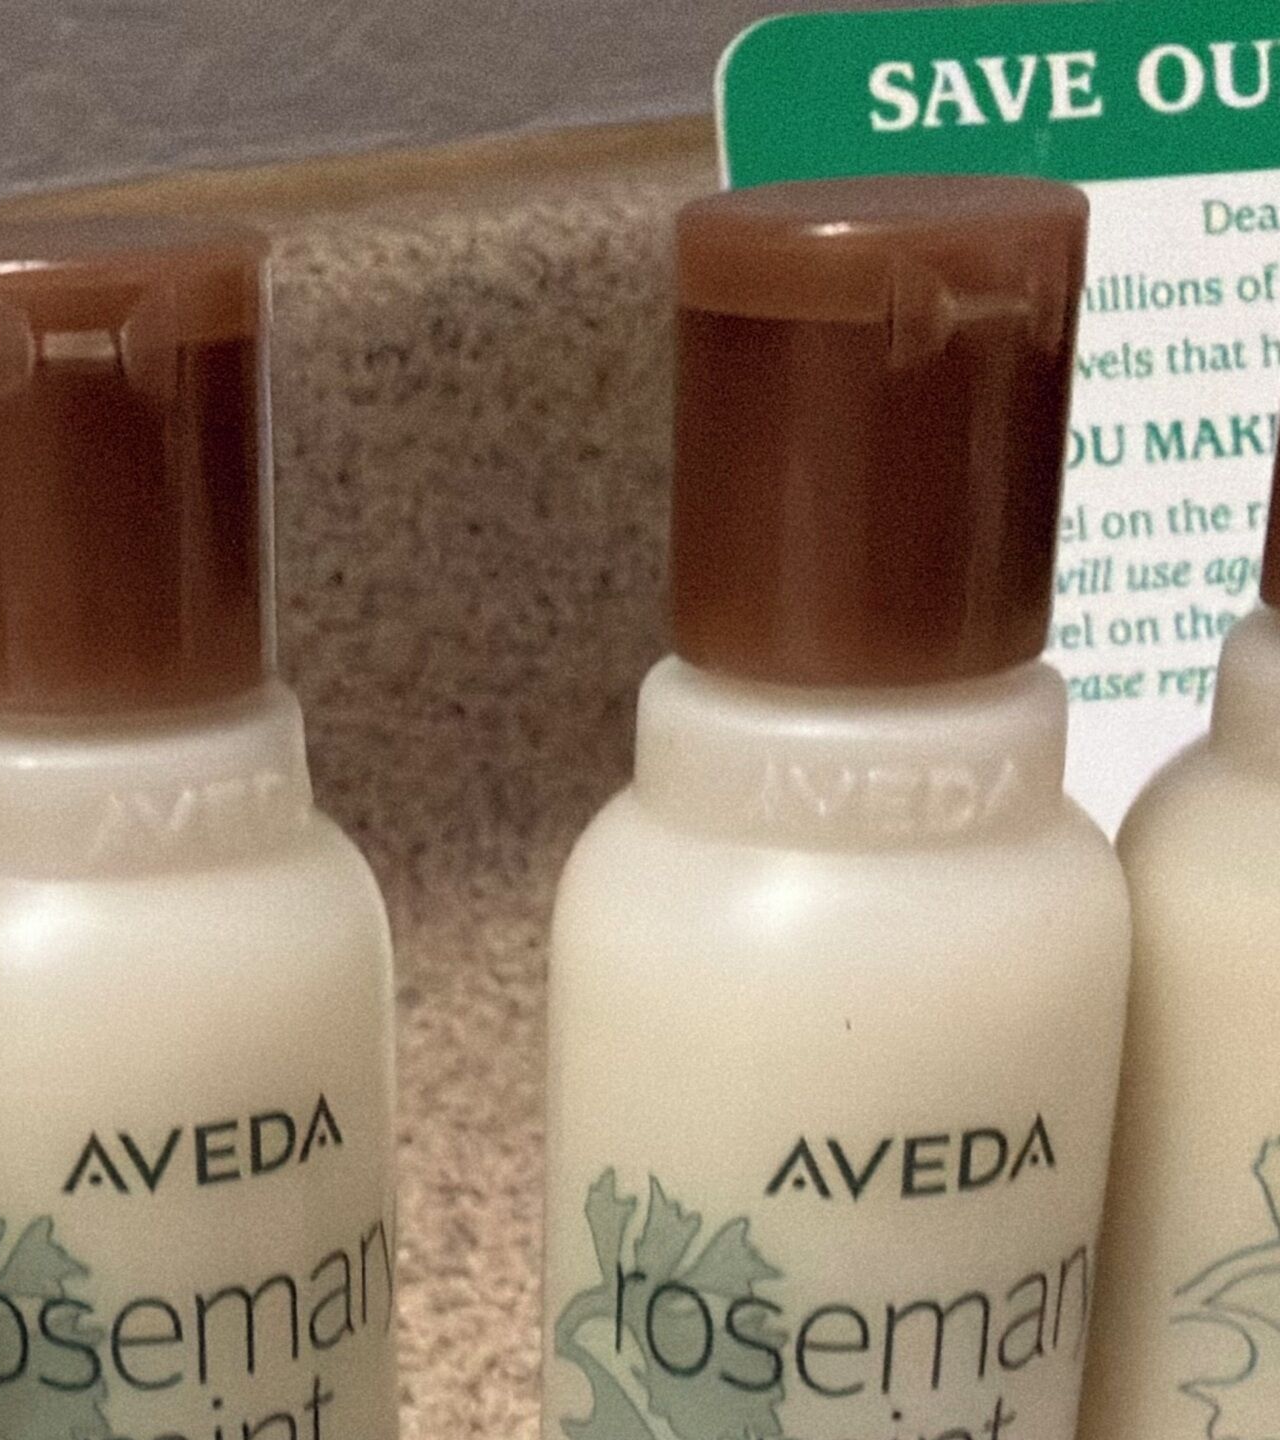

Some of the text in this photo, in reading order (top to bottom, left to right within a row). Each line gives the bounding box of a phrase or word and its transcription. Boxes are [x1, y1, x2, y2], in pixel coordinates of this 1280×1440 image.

[867, 52, 1106, 132] SAVE
[1237, 262, 1278, 303] of
[1167, 336, 1247, 375] that
[1101, 508, 1154, 541] on
[1167, 498, 1233, 535] the
[1126, 559, 1192, 592] use
[1108, 616, 1161, 647] on
[1174, 602, 1237, 642] the
[62, 1093, 346, 1196] AVEDA
[764, 1113, 1057, 1201] AVEDA
